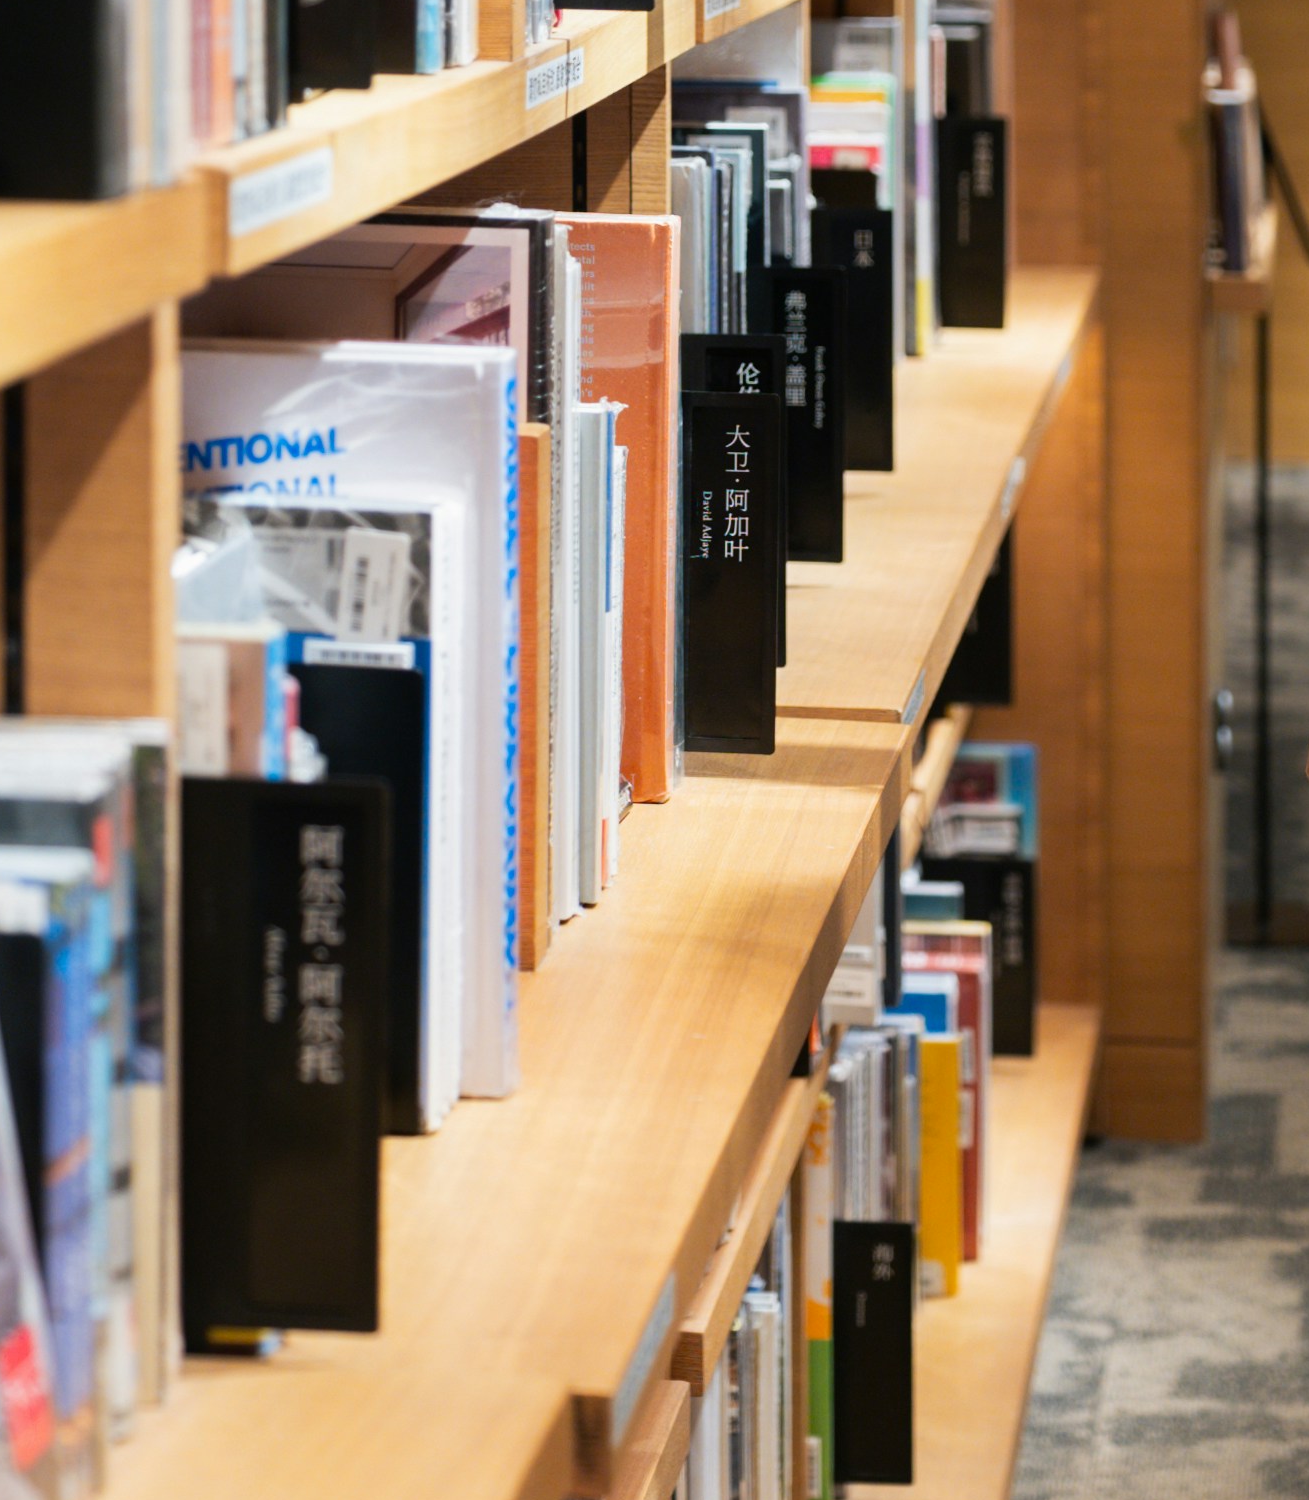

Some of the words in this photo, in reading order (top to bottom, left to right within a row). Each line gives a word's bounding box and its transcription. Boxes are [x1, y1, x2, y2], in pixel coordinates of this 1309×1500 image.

[854, 229, 874, 267] 日本
[785, 291, 807, 406] 弗兰克·盖里
[737, 362, 761, 393] 伦
[702, 490, 713, 521] David
[724, 424, 751, 562] 大卫·阿加叶
[700, 523, 713, 558] Adjaye
